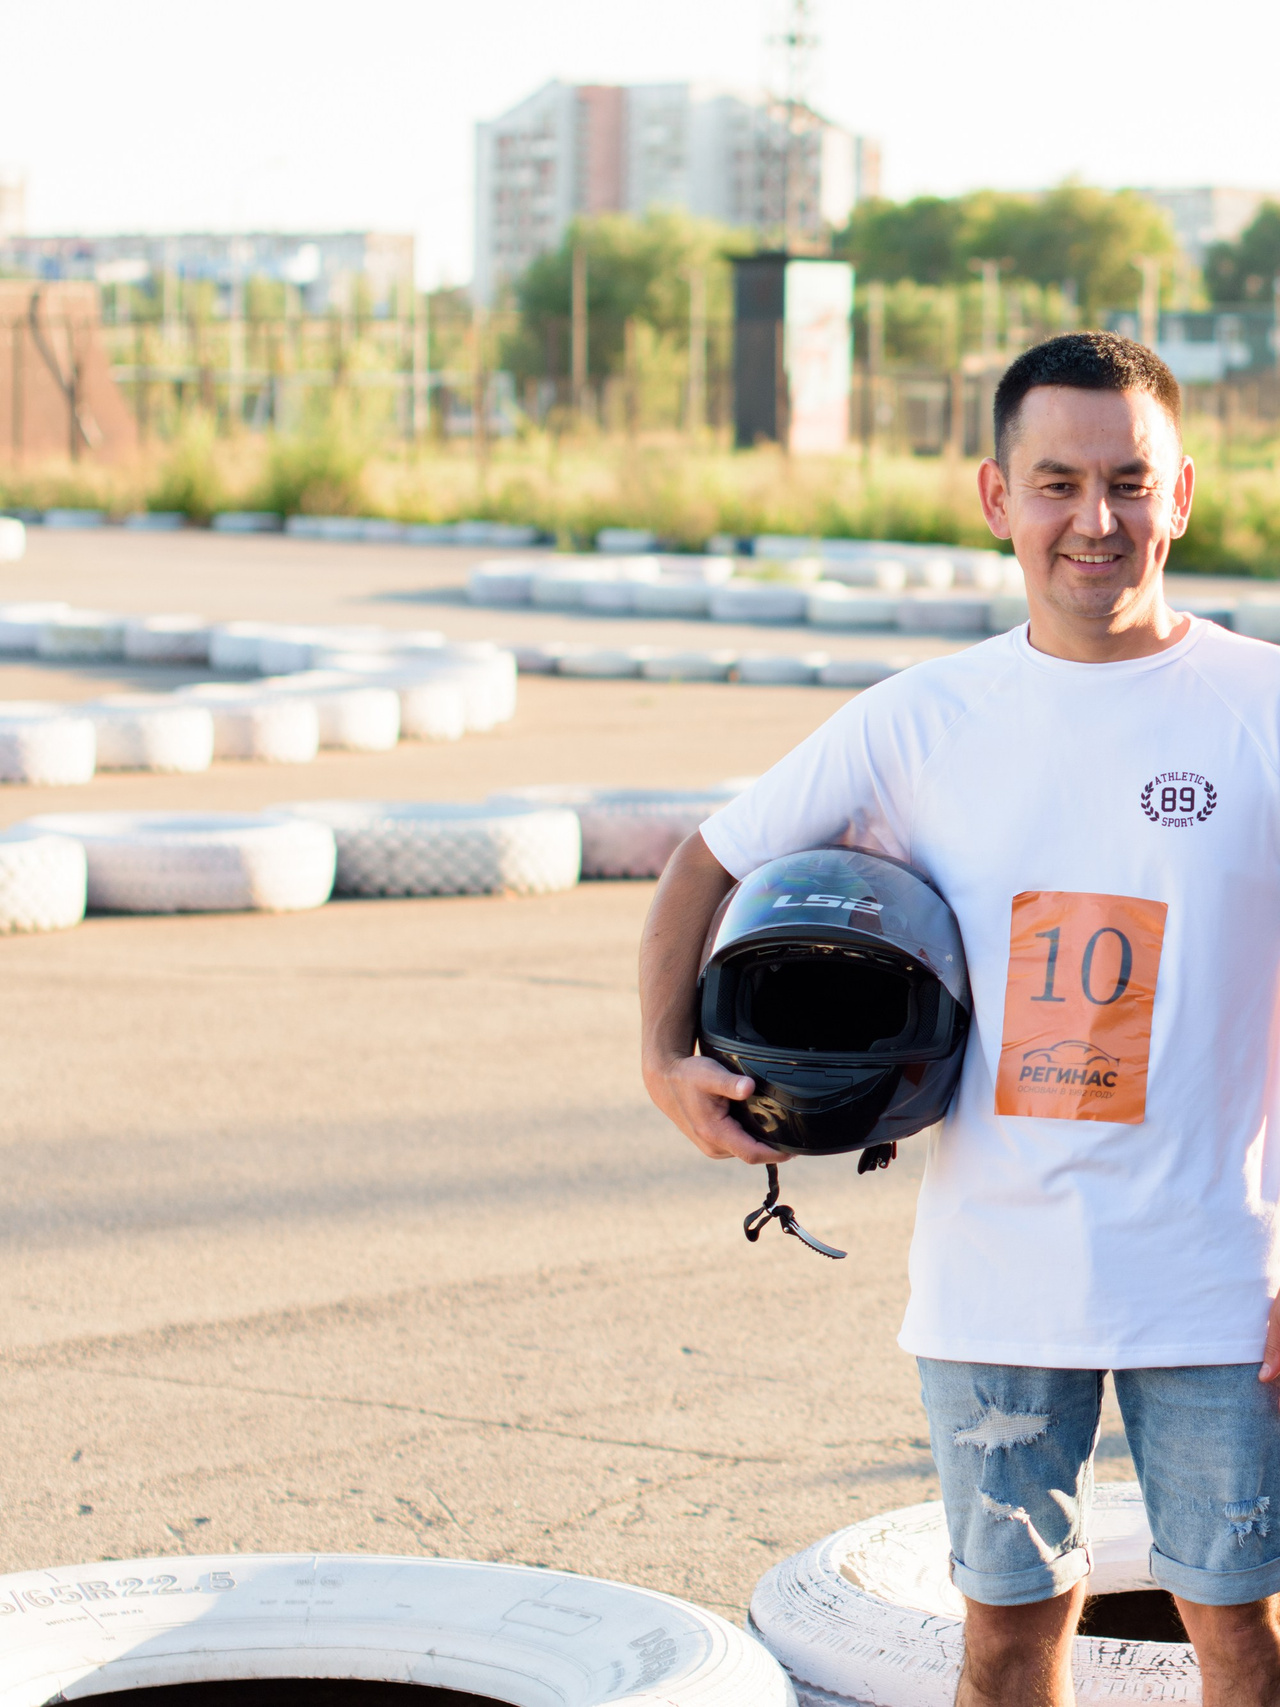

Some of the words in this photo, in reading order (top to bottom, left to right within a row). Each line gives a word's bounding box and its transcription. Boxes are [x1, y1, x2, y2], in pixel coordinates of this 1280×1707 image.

[1154, 771, 1206, 786] ATHLETIC
[1161, 786, 1196, 813] 89
[1161, 816, 1194, 828] SPORT
[772, 893, 885, 916] LS2
[1030, 926, 1133, 1006] 10
[1018, 1065, 1119, 1088] РЕГИНАС
[1017, 1085, 1058, 1095] ОСНОВАН
[1060, 1087, 1068, 1096] В
[1069, 1088, 1087, 1097] 1992
[1089, 1090, 1117, 1100] ГОДУ
